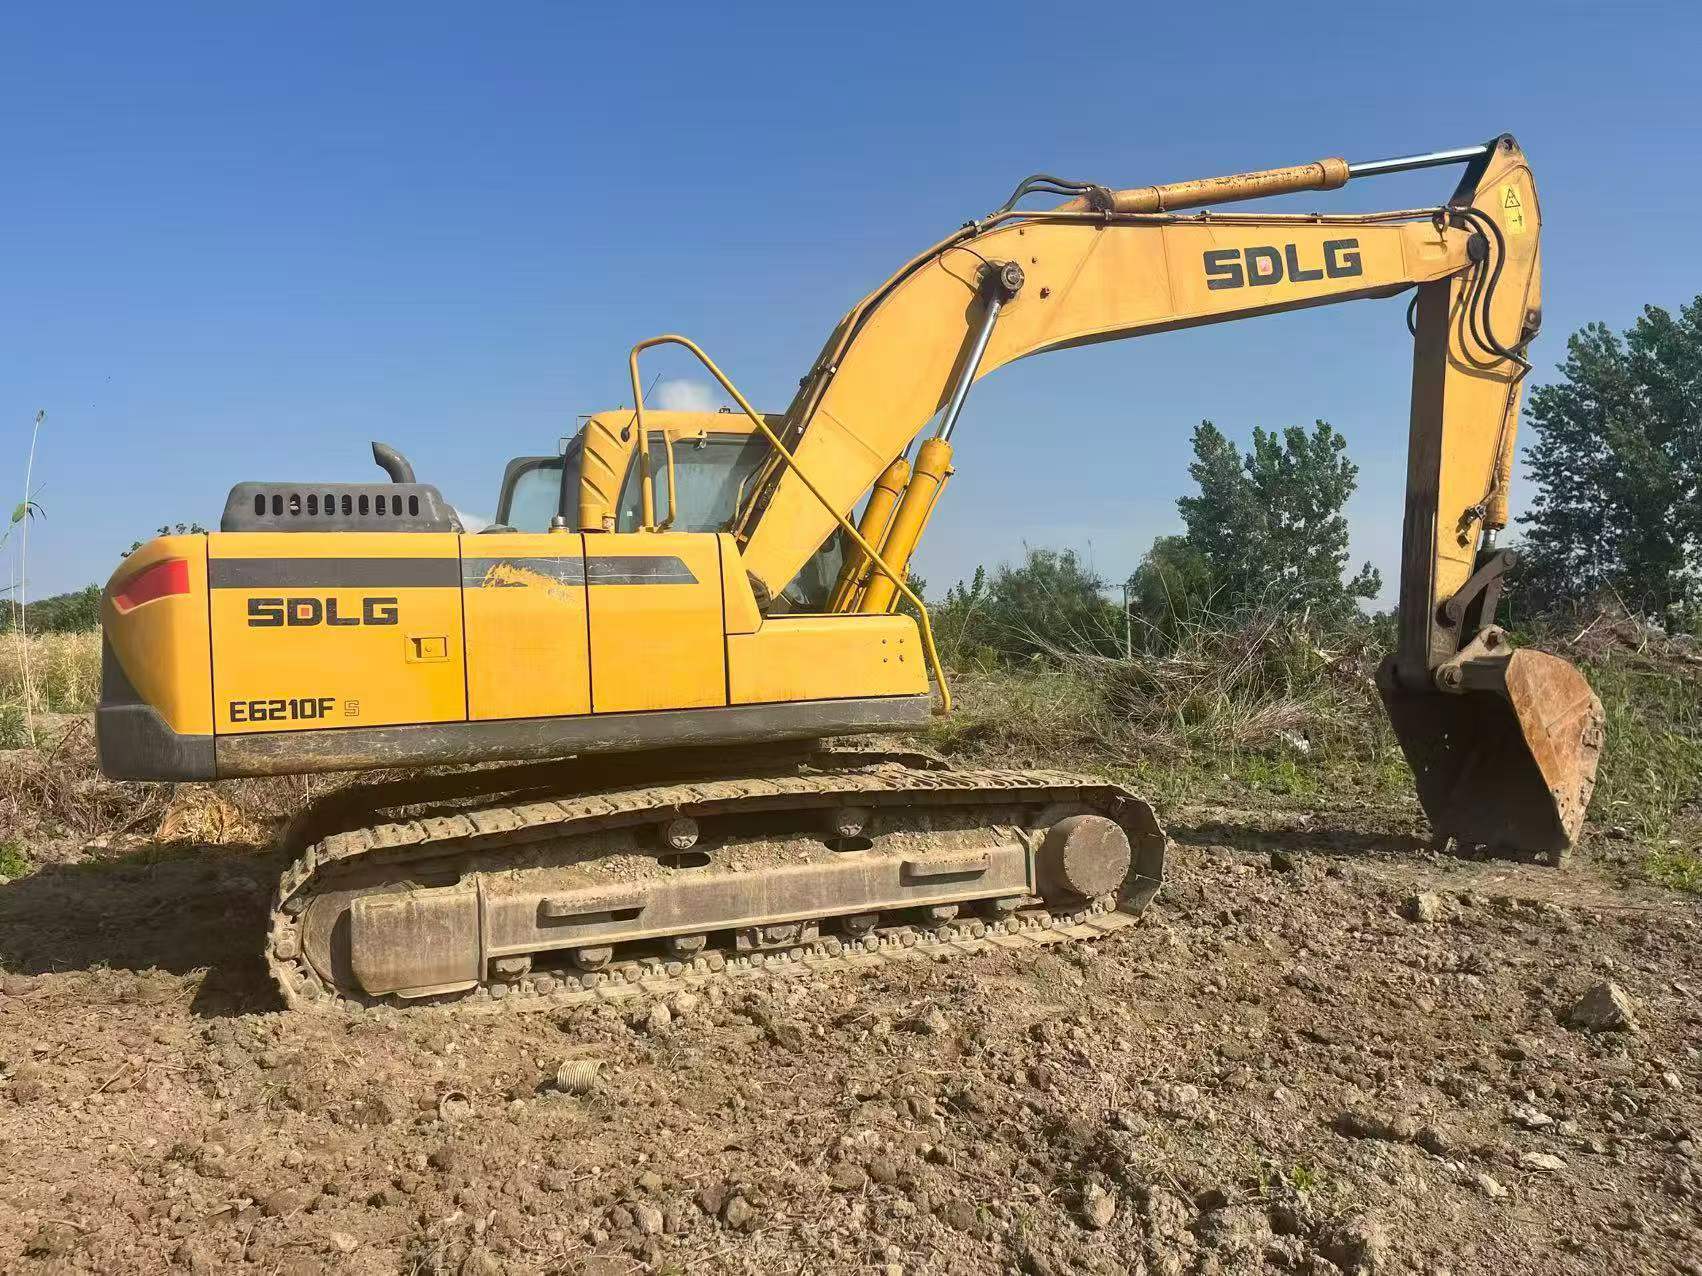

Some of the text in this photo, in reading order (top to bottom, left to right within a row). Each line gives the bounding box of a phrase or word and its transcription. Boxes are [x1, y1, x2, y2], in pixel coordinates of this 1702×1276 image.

[1203, 238, 1363, 290] SDLG
[247, 597, 399, 627] SDLG
[229, 697, 336, 722] E6210F
